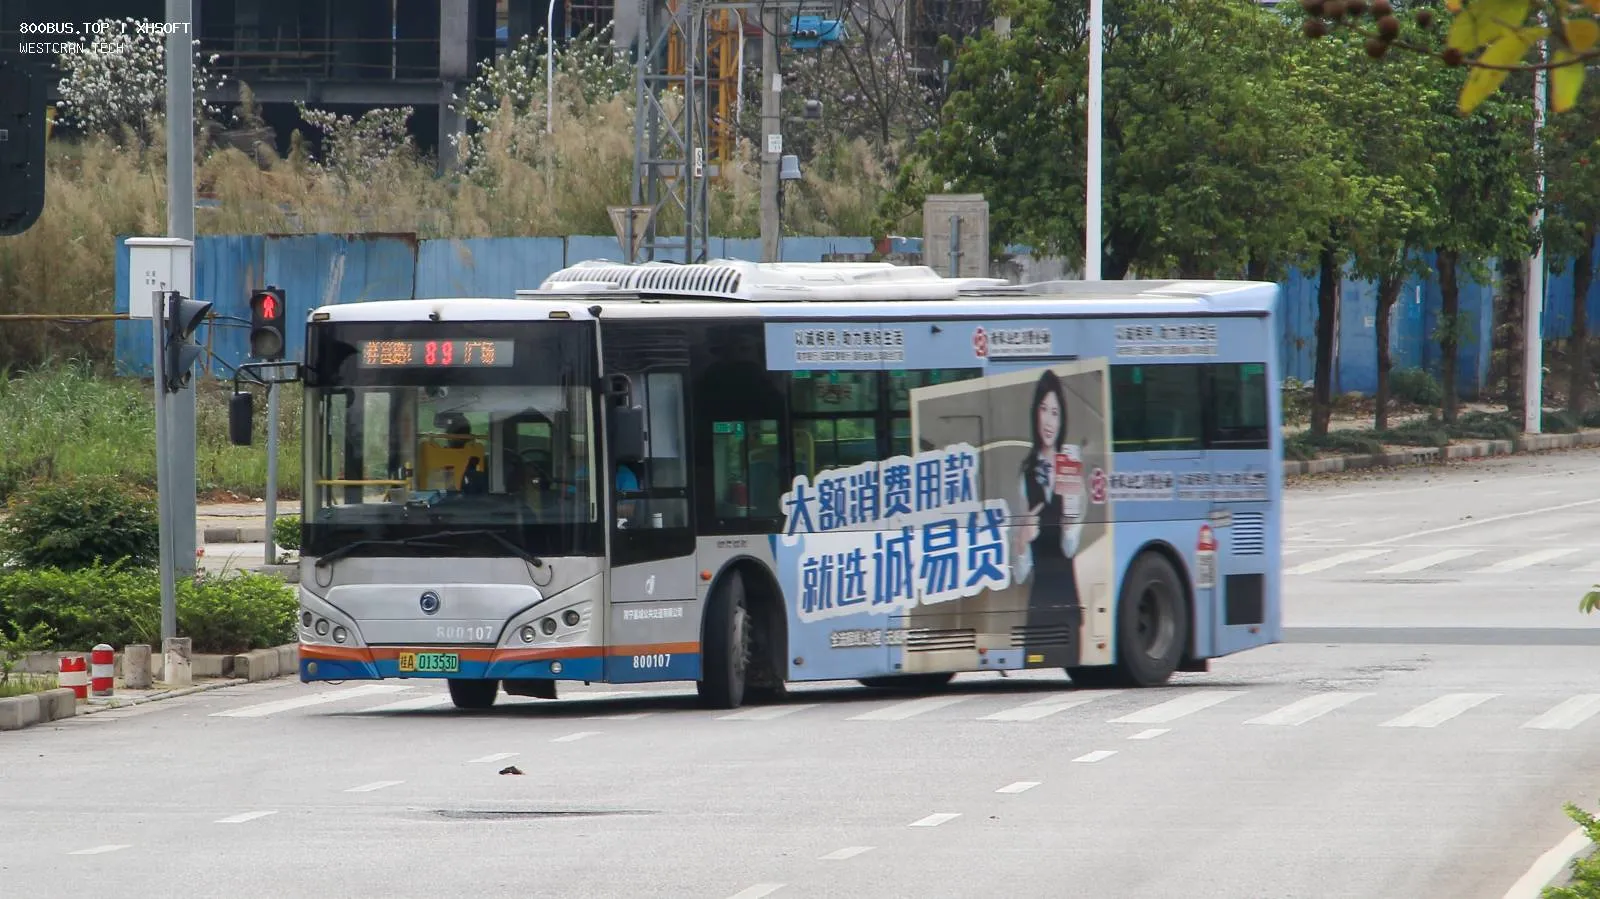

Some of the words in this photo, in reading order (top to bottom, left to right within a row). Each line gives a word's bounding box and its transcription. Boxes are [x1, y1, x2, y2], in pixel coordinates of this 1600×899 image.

[424, 340, 453, 365] 89
[785, 451, 974, 537] 大额消费用款
[801, 508, 1006, 614] 就选诚易贷
[436, 625, 494, 641] 800107
[633, 653, 671, 669] 800107
